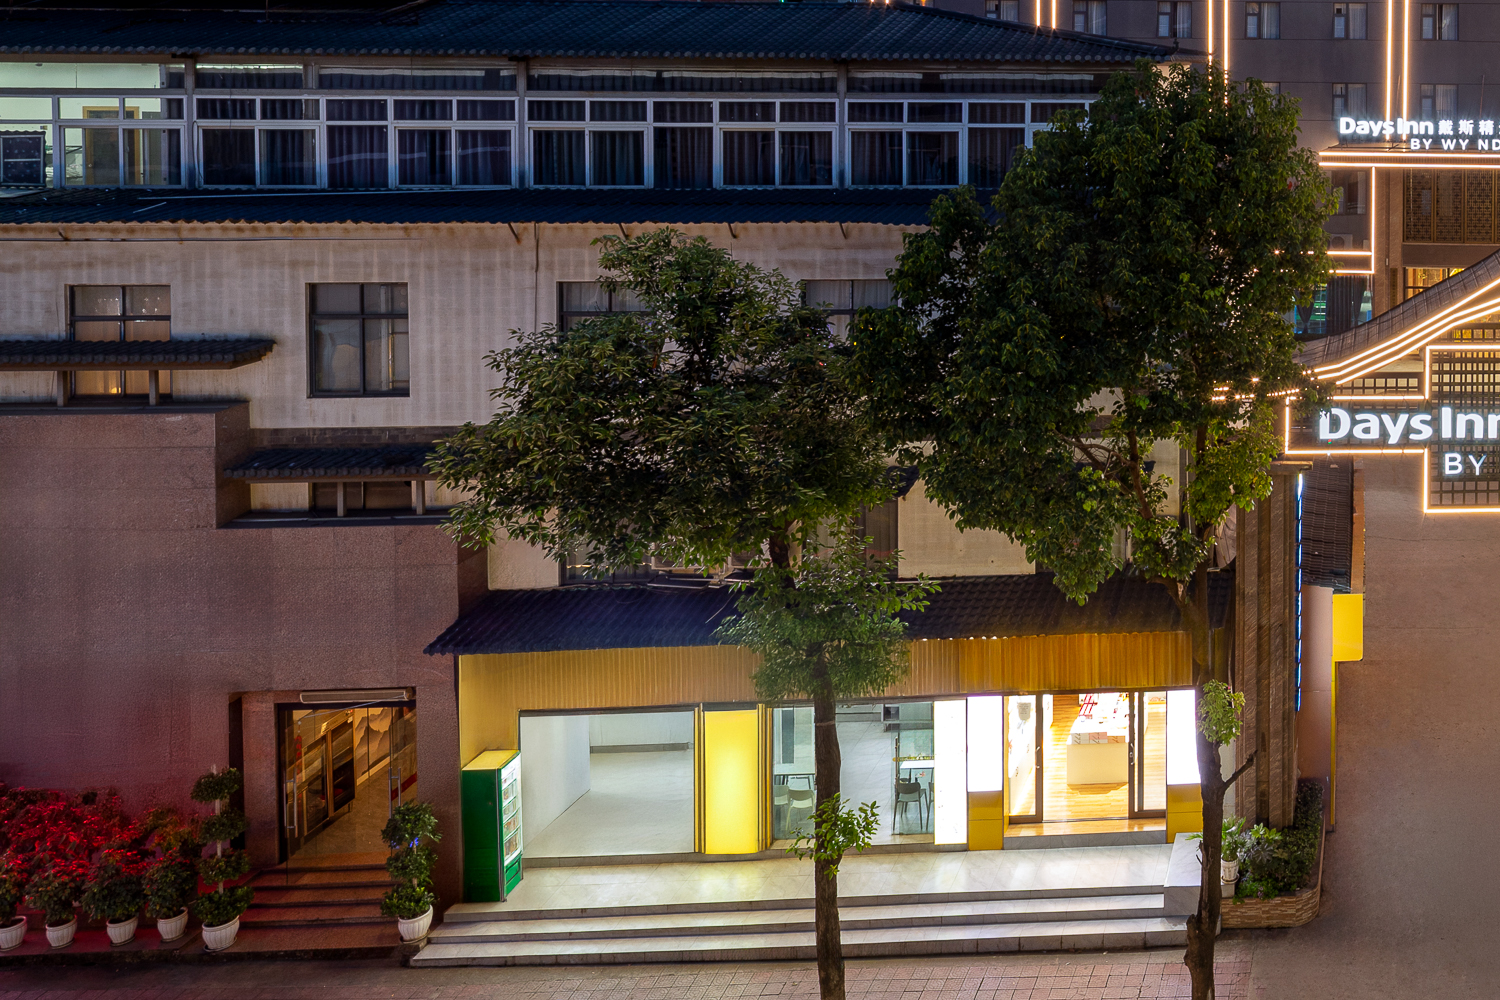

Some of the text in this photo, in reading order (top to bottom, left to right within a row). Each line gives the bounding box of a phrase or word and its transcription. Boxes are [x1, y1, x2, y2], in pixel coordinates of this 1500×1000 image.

[1339, 117, 1434, 137] Days Inn
[1410, 138, 1432, 150] BY
[1319, 407, 1433, 444] Days
[1444, 453, 1486, 476] BY
